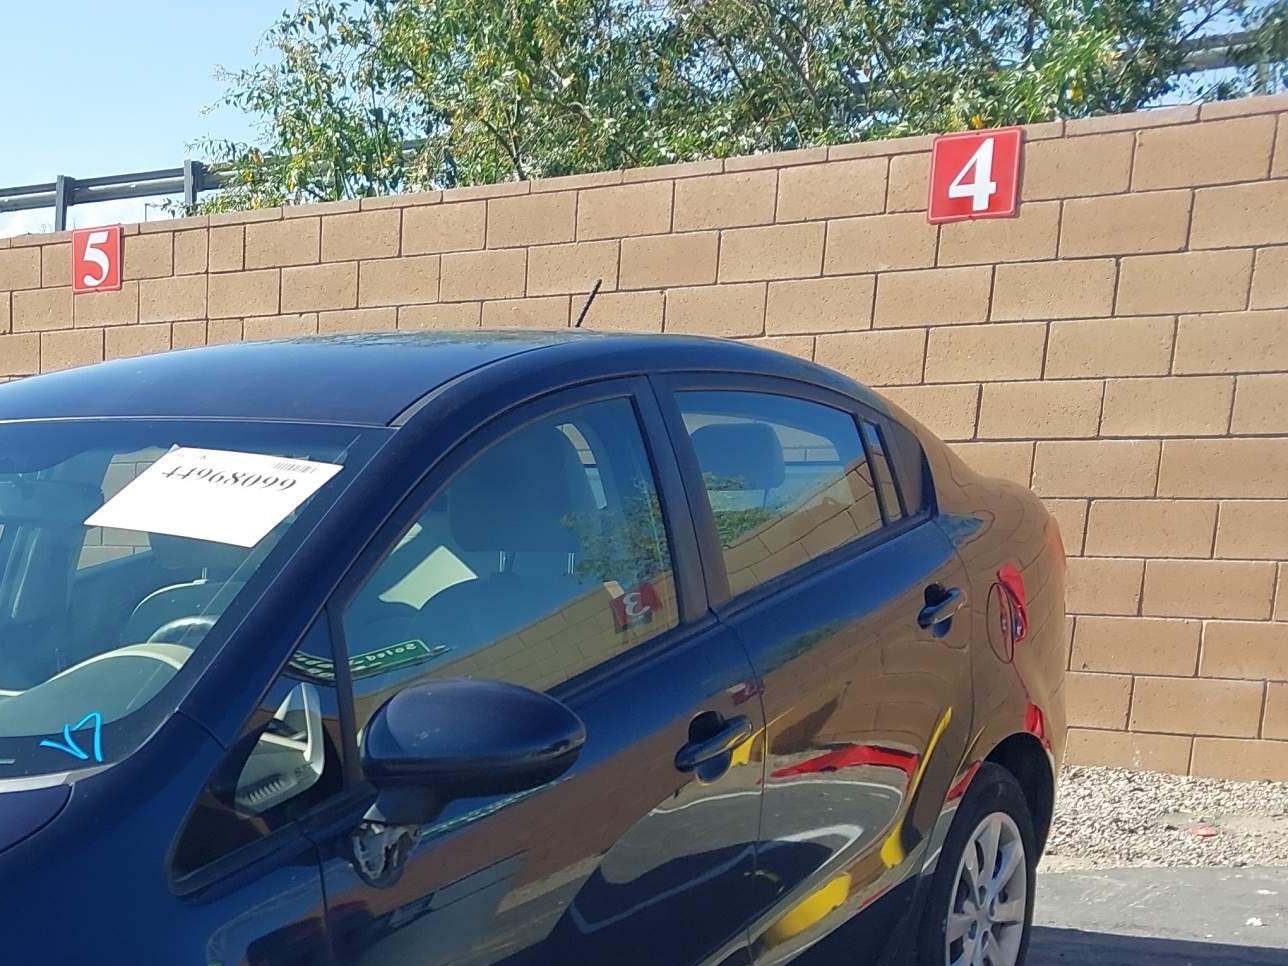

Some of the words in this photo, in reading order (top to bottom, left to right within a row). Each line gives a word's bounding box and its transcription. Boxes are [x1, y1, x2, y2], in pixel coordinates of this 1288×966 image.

[948, 137, 996, 211] 4
[83, 231, 109, 287] 5
[161, 464, 297, 492] 44968099
